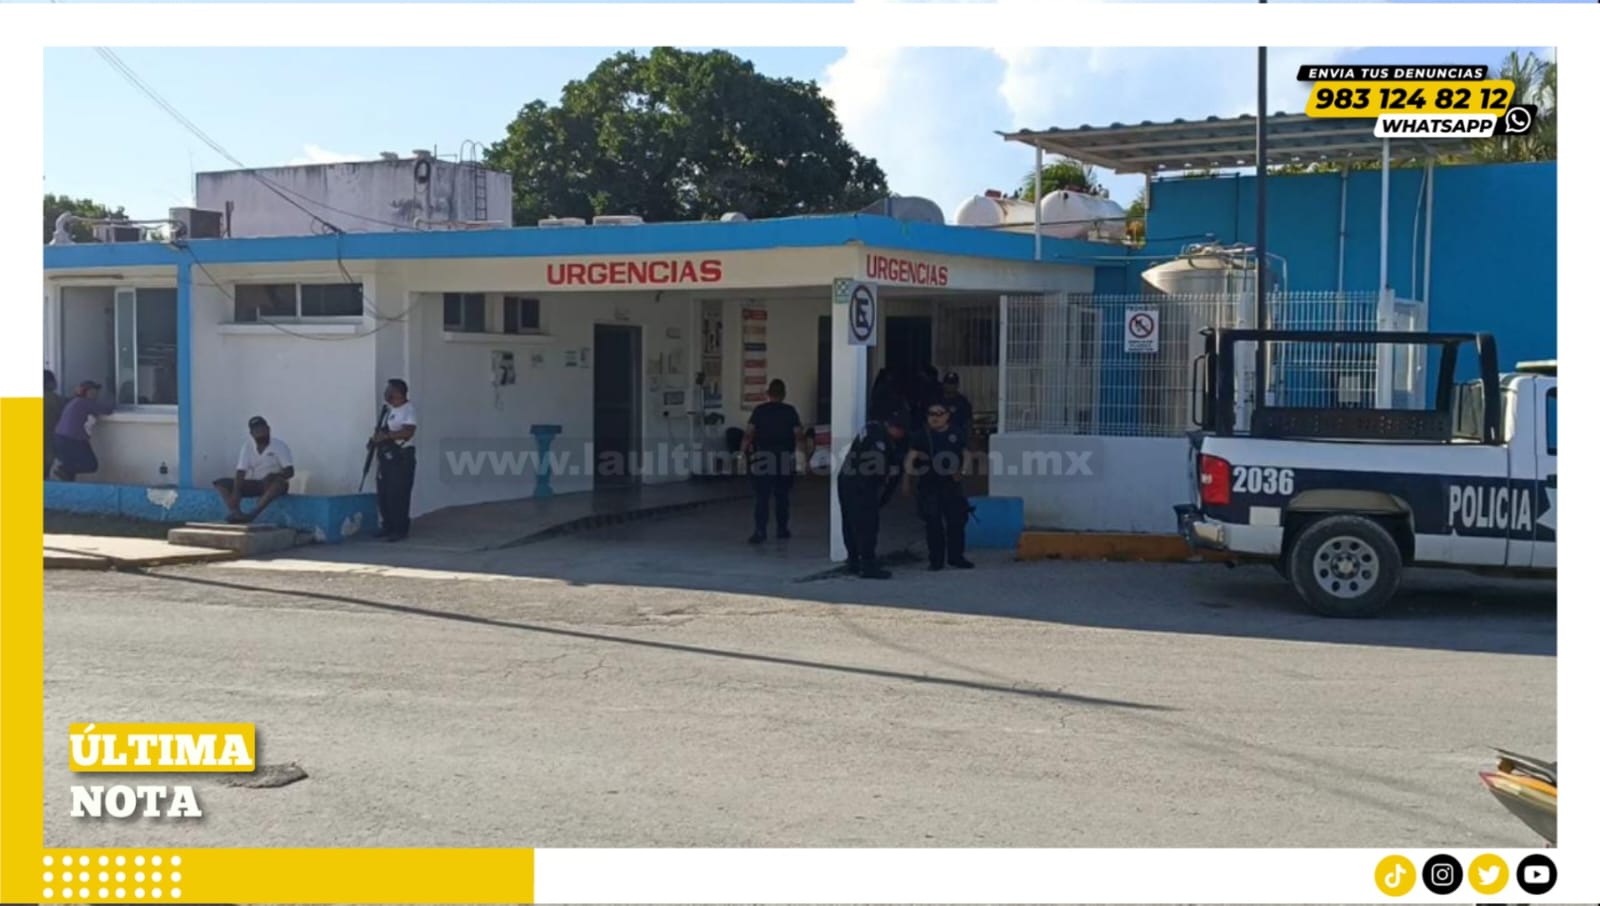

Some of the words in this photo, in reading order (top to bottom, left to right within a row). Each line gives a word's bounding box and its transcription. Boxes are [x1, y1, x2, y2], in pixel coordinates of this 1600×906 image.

[546, 259, 723, 286] URGENCIAS
[866, 253, 949, 286] URGENCIAS
[1231, 466, 1295, 495] 2036
[1448, 485, 1533, 532] POLICIA
